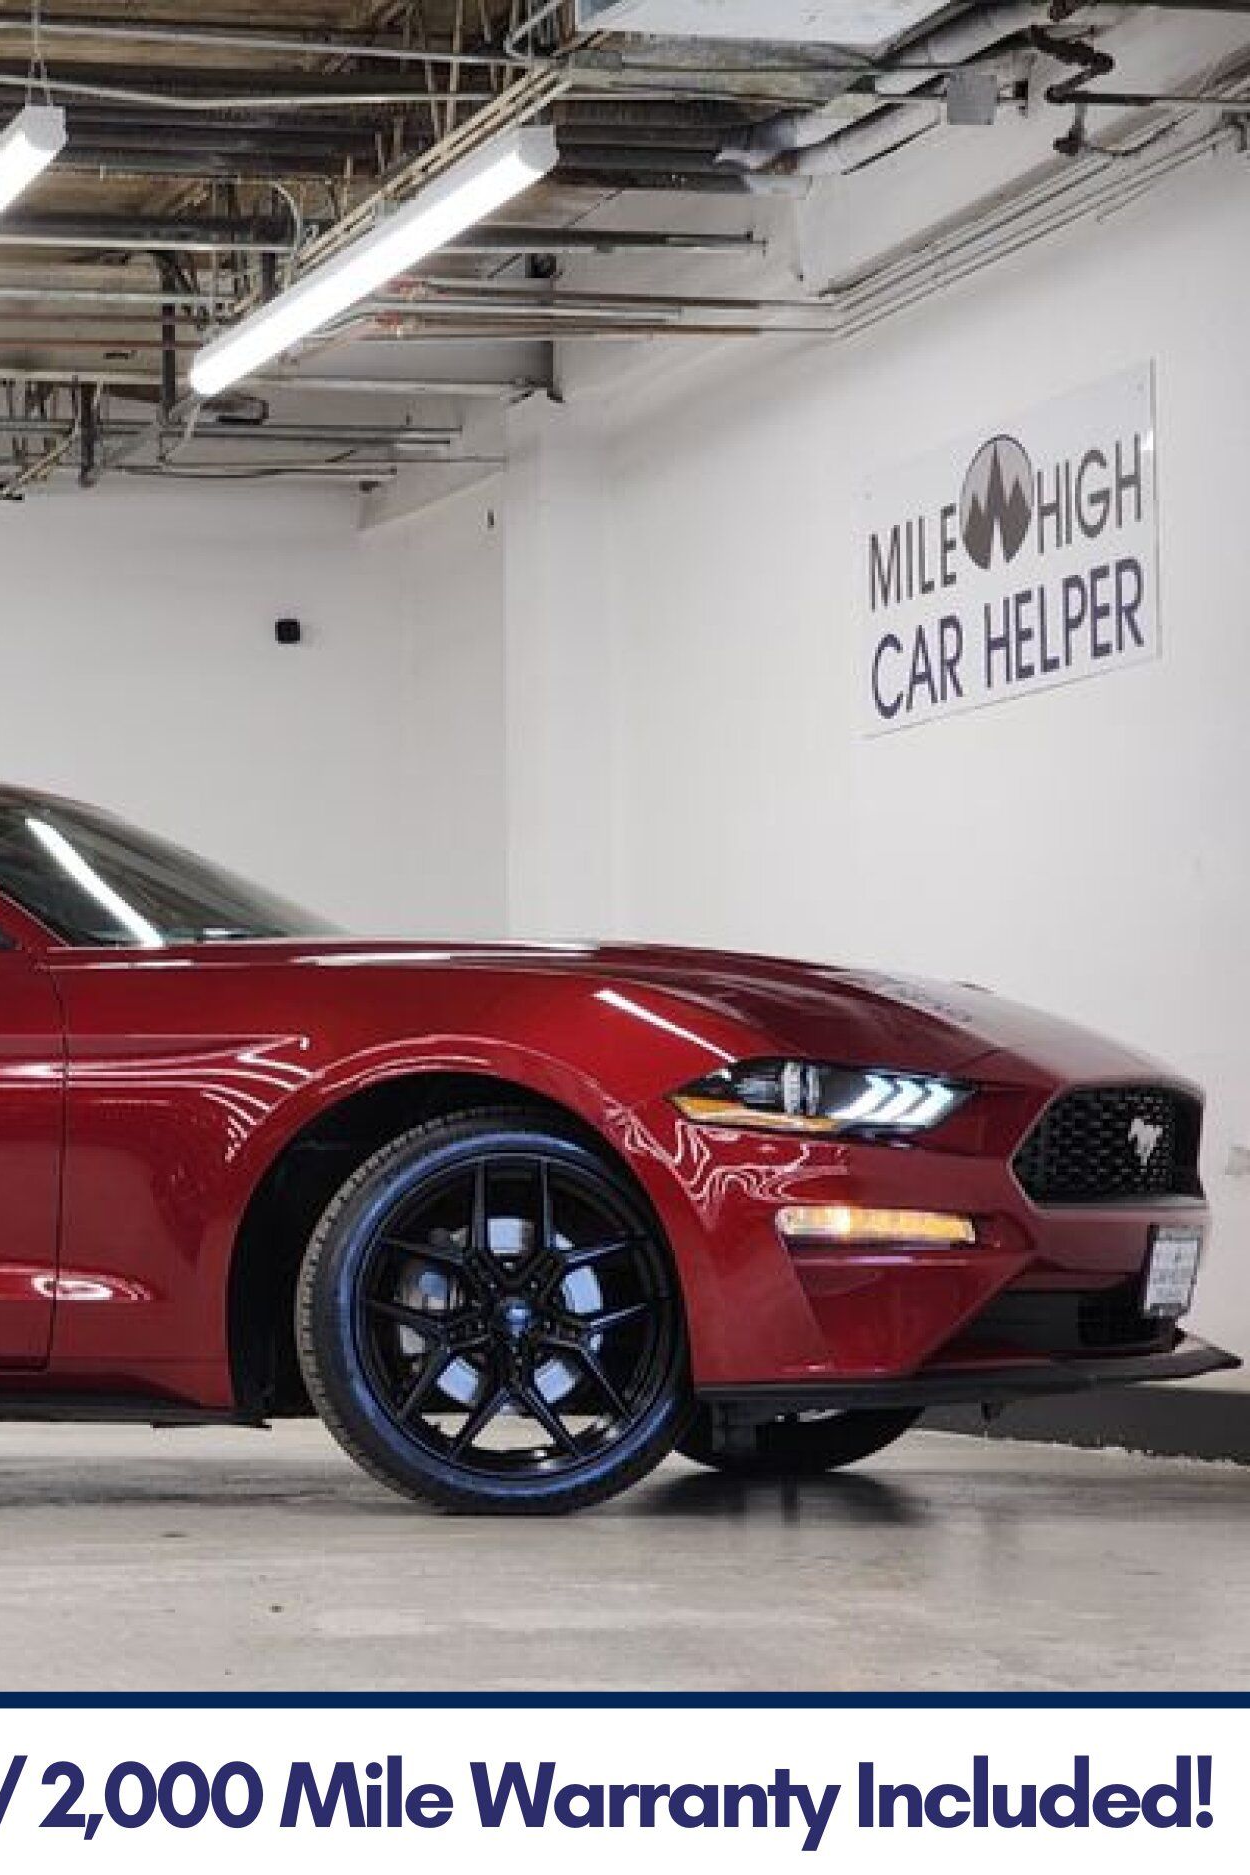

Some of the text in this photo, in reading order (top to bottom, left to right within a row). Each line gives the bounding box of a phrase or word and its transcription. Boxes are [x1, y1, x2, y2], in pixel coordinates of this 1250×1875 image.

[869, 432, 1142, 613] MILE HIGH
[871, 558, 1145, 719] CAR HELPER
